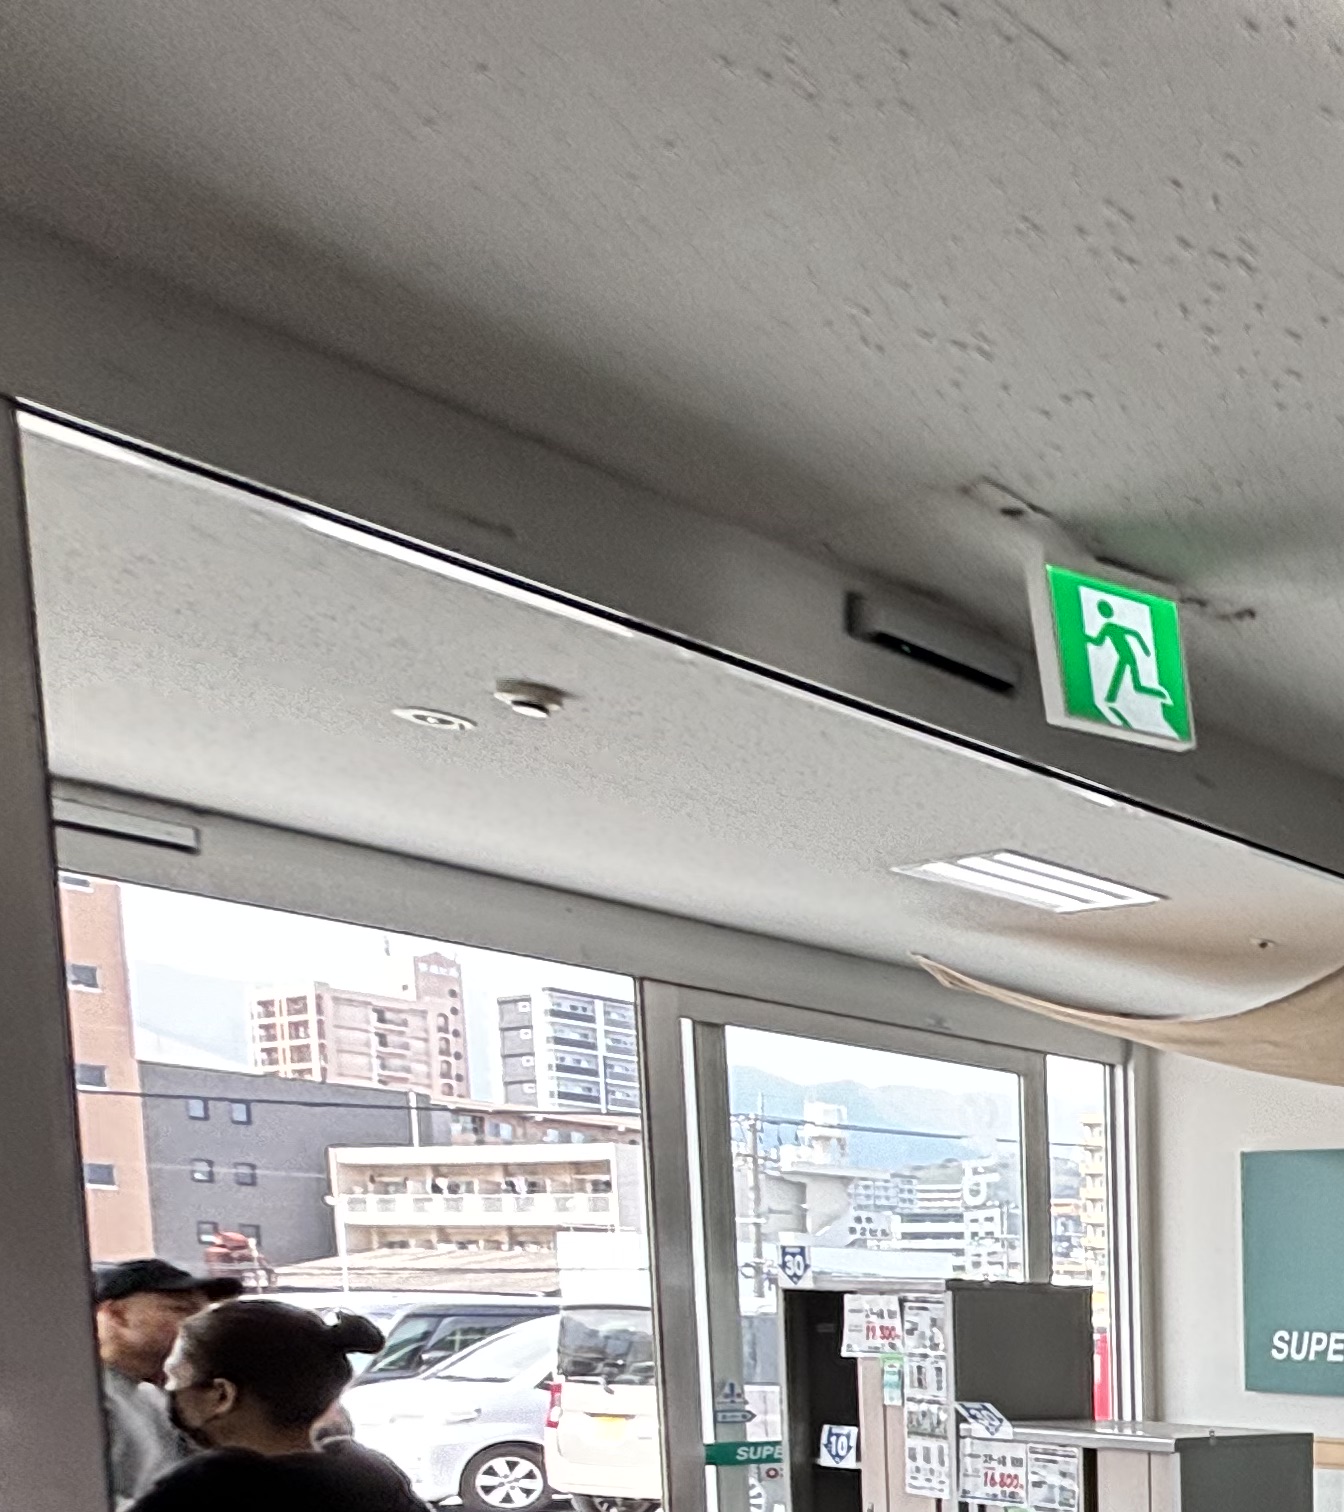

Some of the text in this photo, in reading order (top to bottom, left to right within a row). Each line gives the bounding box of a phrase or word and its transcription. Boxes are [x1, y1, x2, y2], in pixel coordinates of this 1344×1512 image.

[784, 1254, 804, 1277] 30
[736, 1446, 784, 1461] SUPE
[829, 1434, 848, 1457] 10
